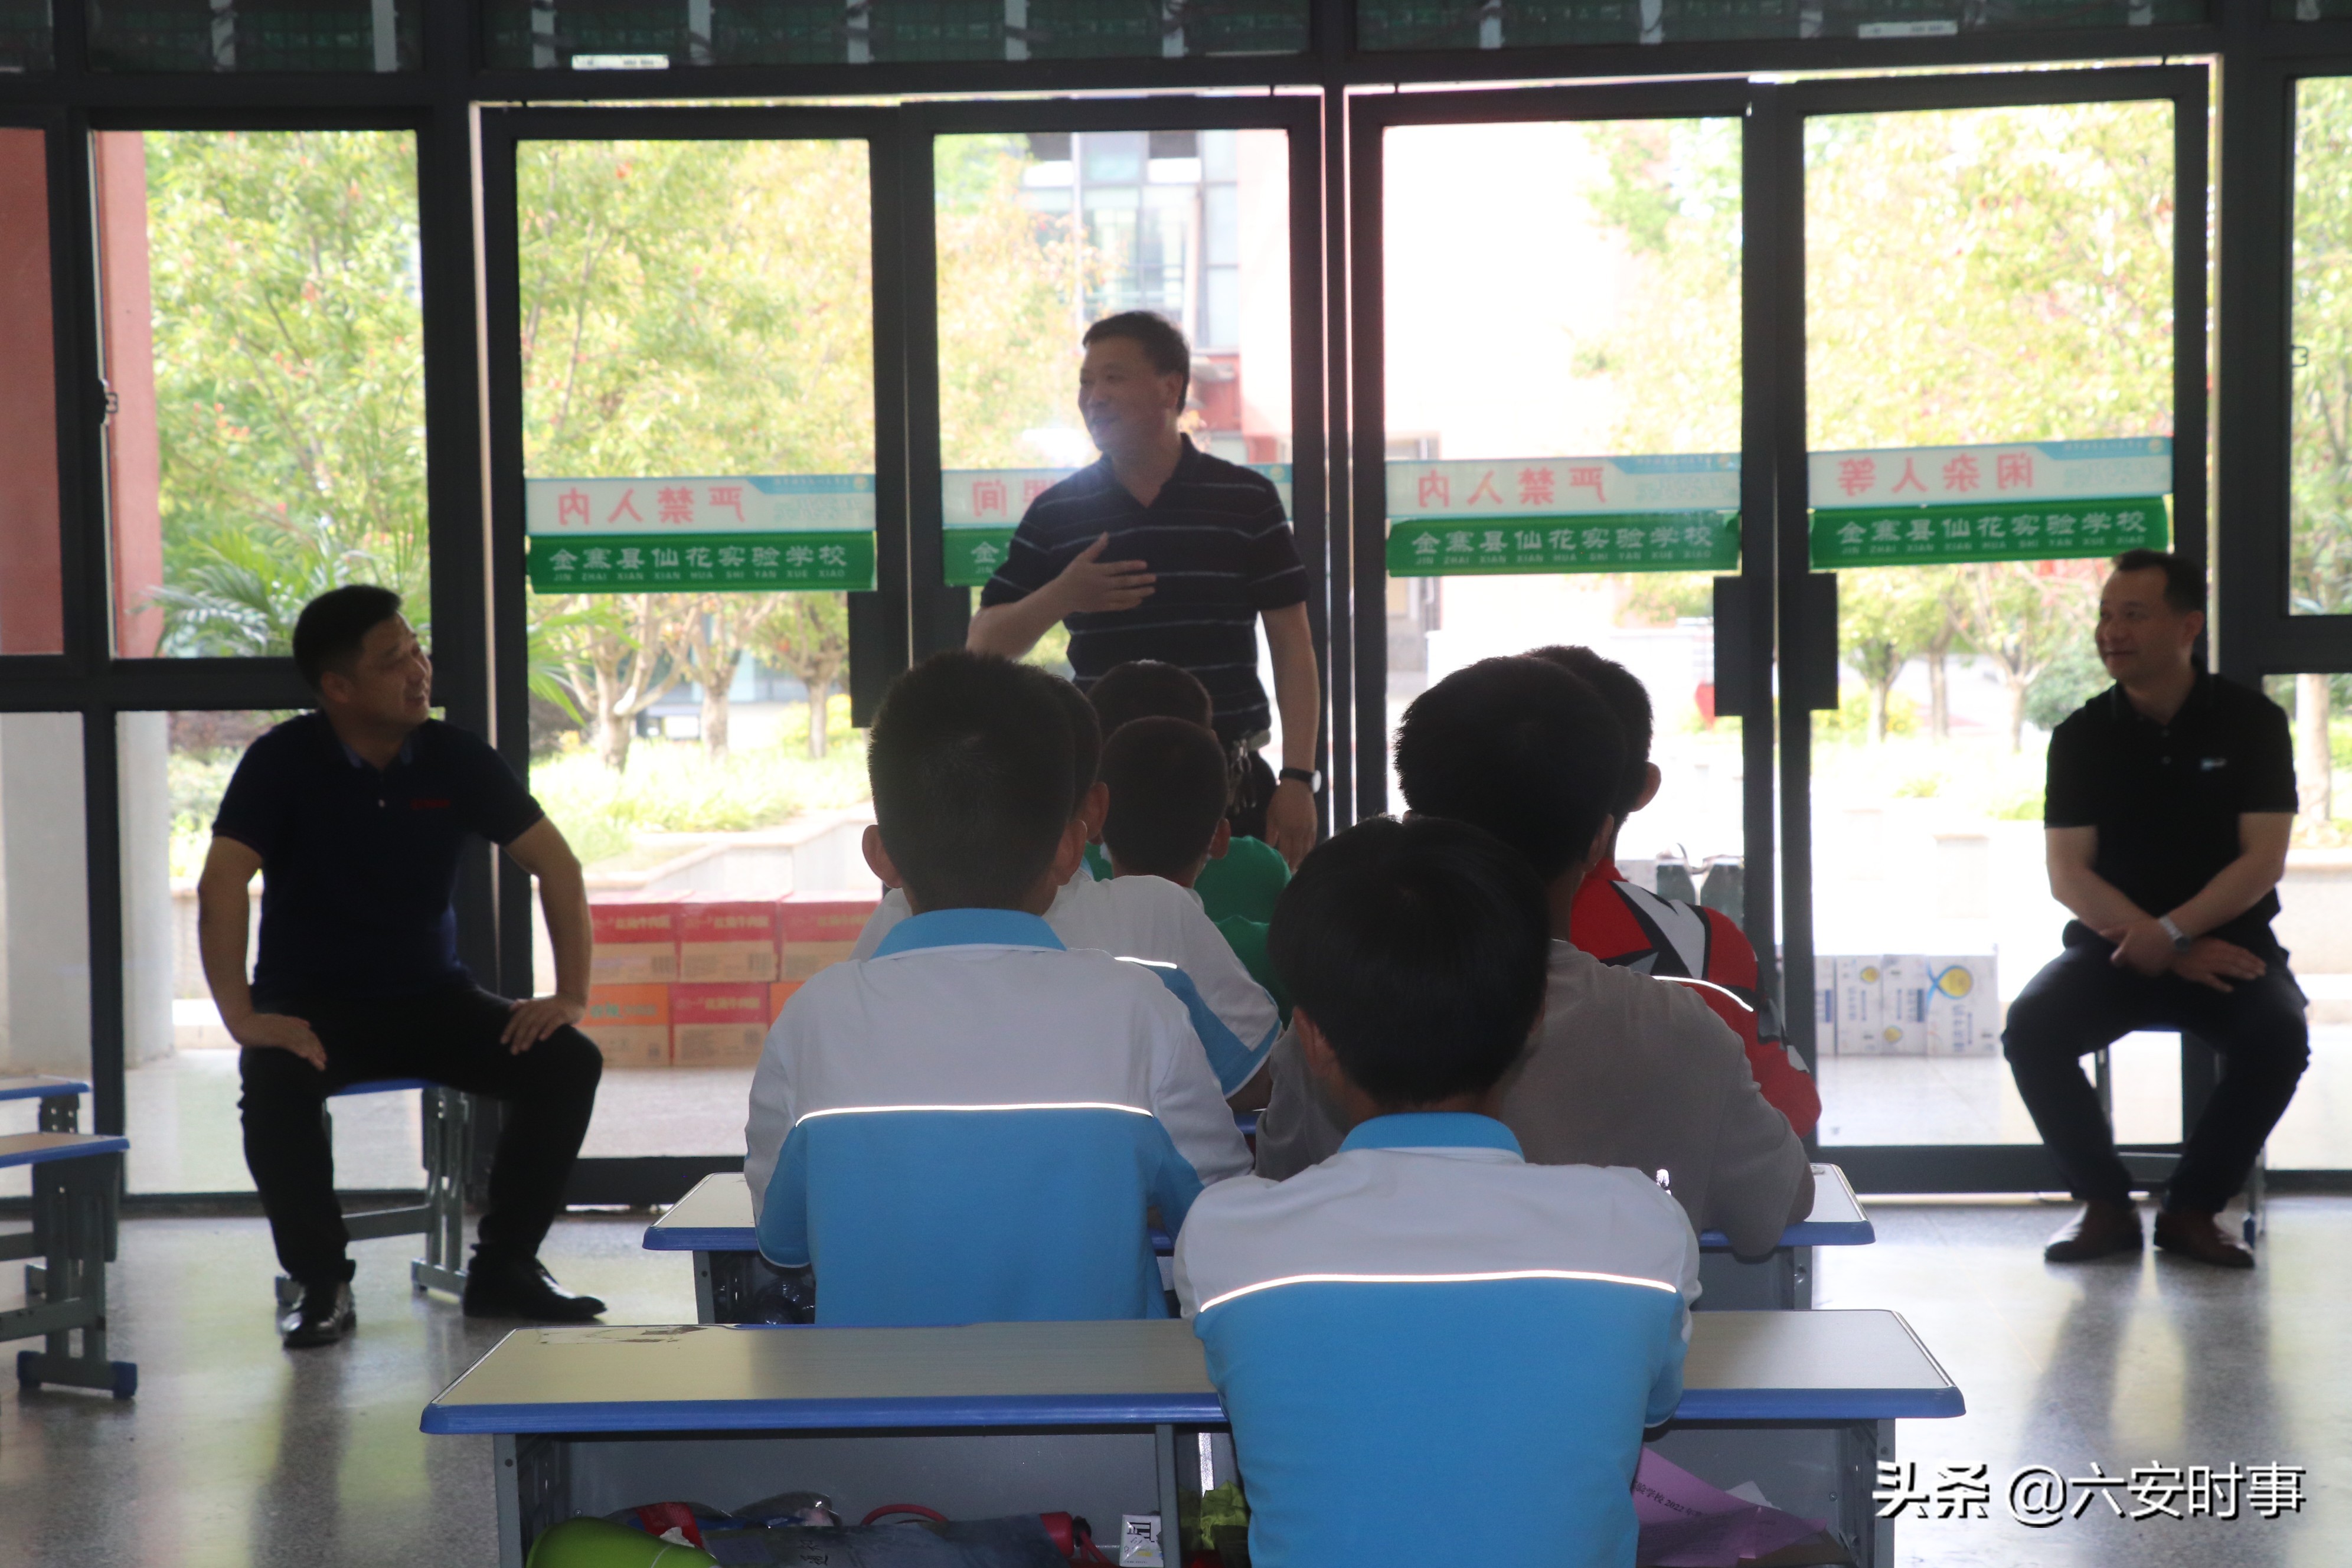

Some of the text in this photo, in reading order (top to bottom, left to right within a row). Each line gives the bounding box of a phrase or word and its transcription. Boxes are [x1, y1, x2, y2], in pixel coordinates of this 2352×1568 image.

[1412, 527, 1713, 554] 金寨县仙花实验学校
[1837, 511, 2147, 544] 金寨县仙花实验学校
[549, 545, 847, 571] 金寨县仙花实验学校
[1664, 1500, 1684, 1513] 2022
